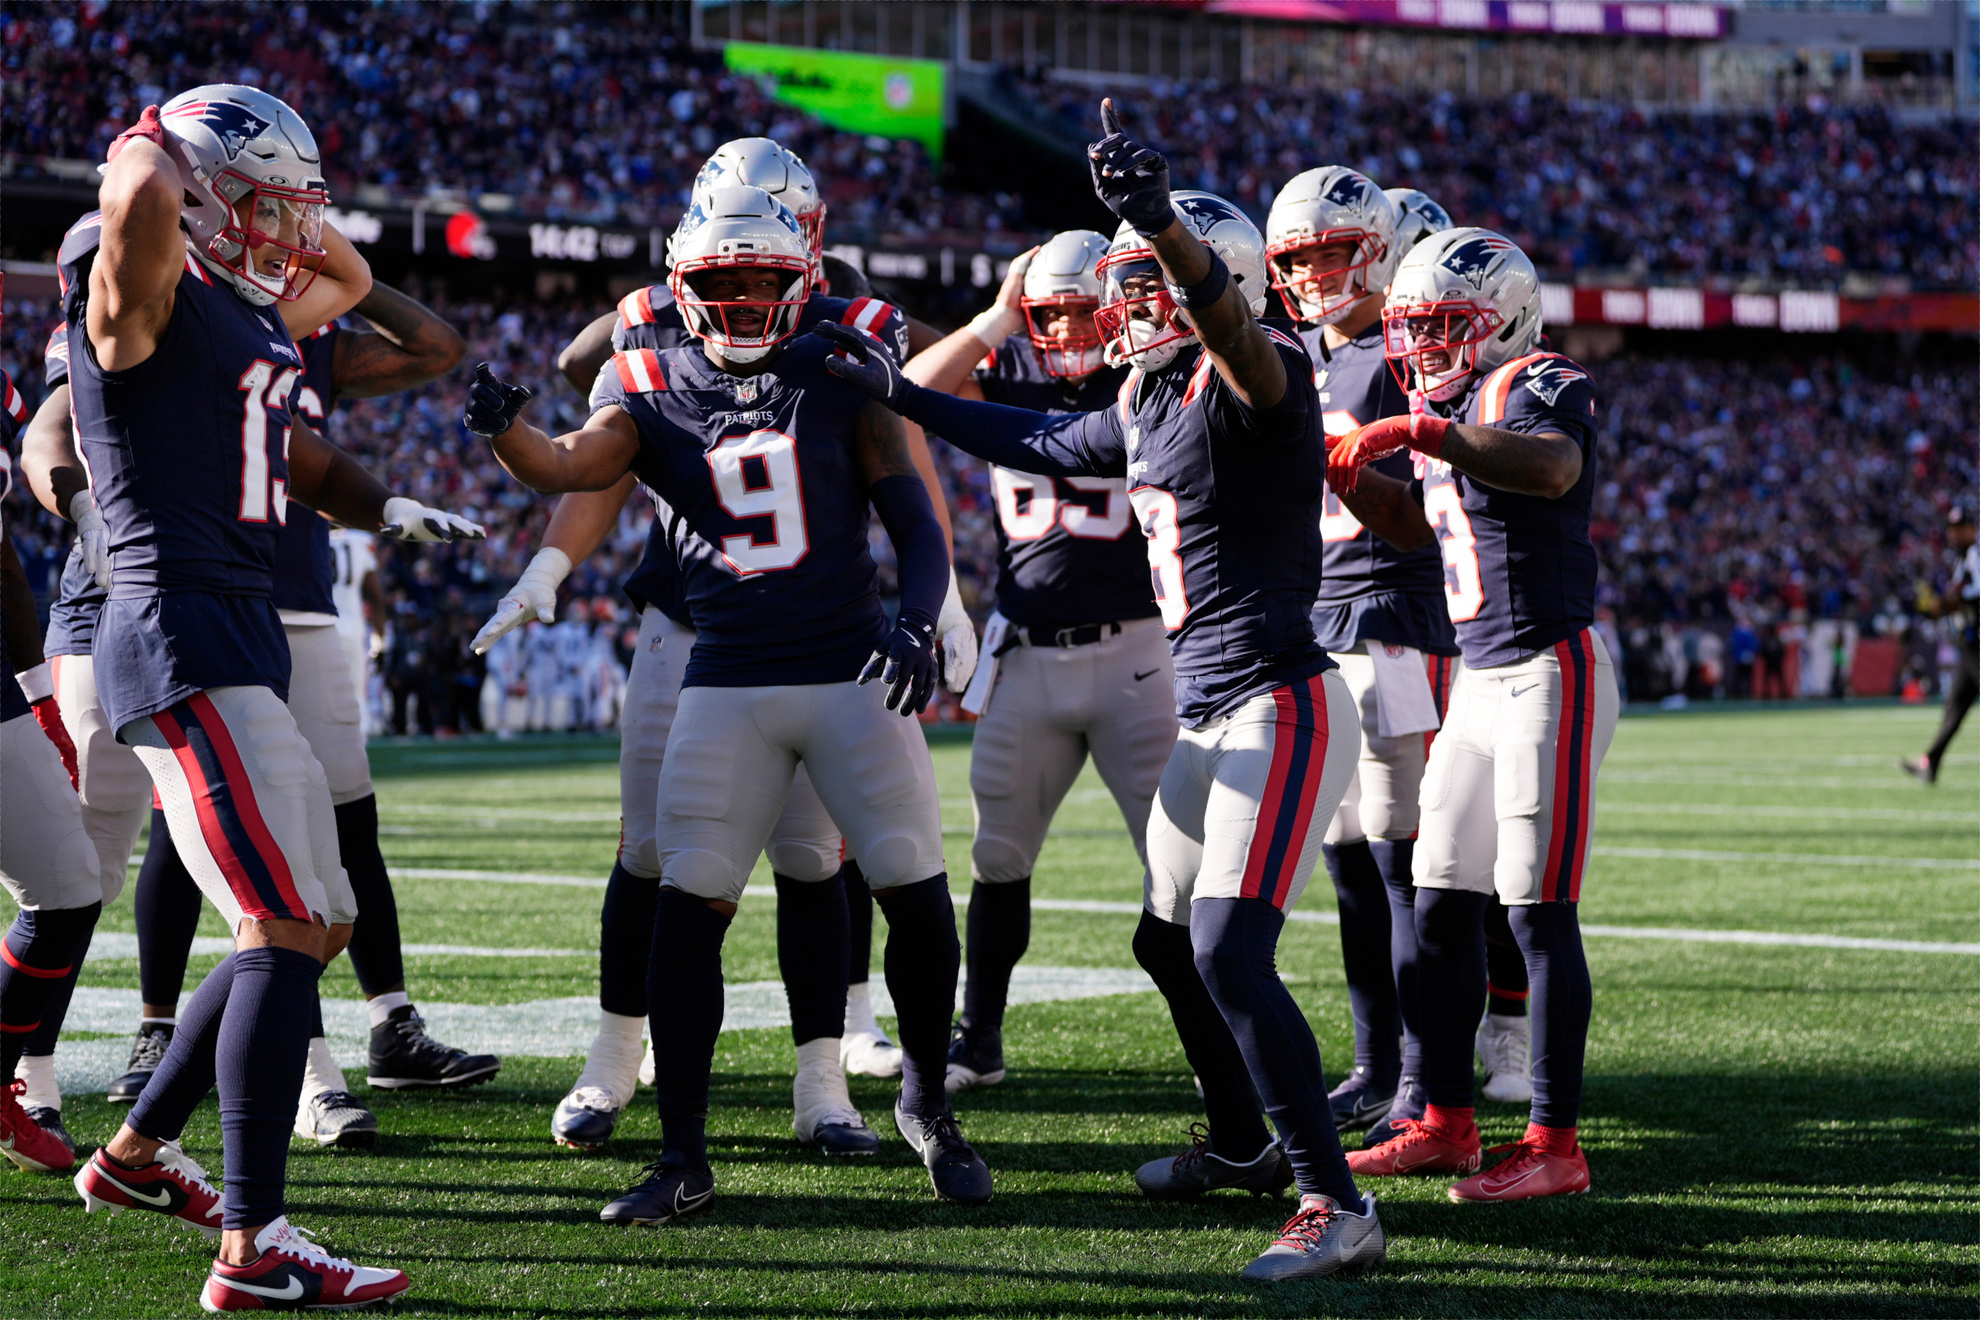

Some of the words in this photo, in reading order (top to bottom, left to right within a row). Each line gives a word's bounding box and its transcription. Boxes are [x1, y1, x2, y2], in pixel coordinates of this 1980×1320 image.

[724, 410, 774, 426] PATRIOTS
[707, 428, 811, 576] 9
[1424, 482, 1486, 624] 3
